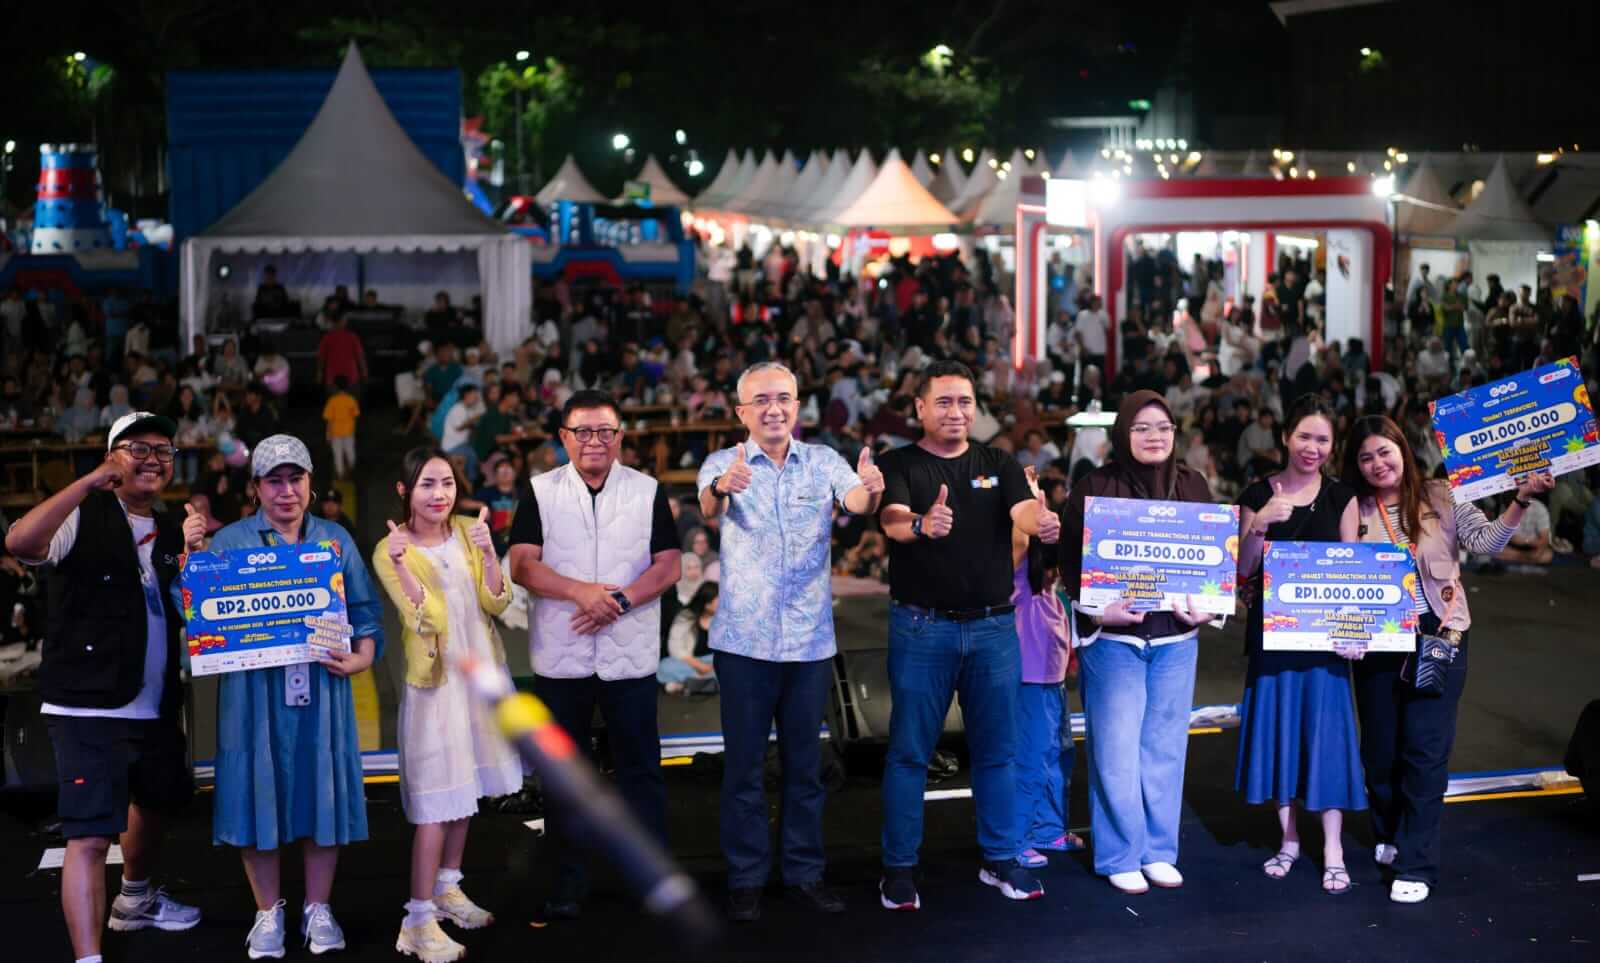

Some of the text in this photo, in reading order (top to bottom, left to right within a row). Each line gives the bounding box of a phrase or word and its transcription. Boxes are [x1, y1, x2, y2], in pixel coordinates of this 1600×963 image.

[1470, 410, 1559, 447] RP1.000.000
[1115, 543, 1205, 561] RP1.500.000
[217, 592, 315, 615] RP2.000.000
[1295, 587, 1384, 600] RP1.000.000
